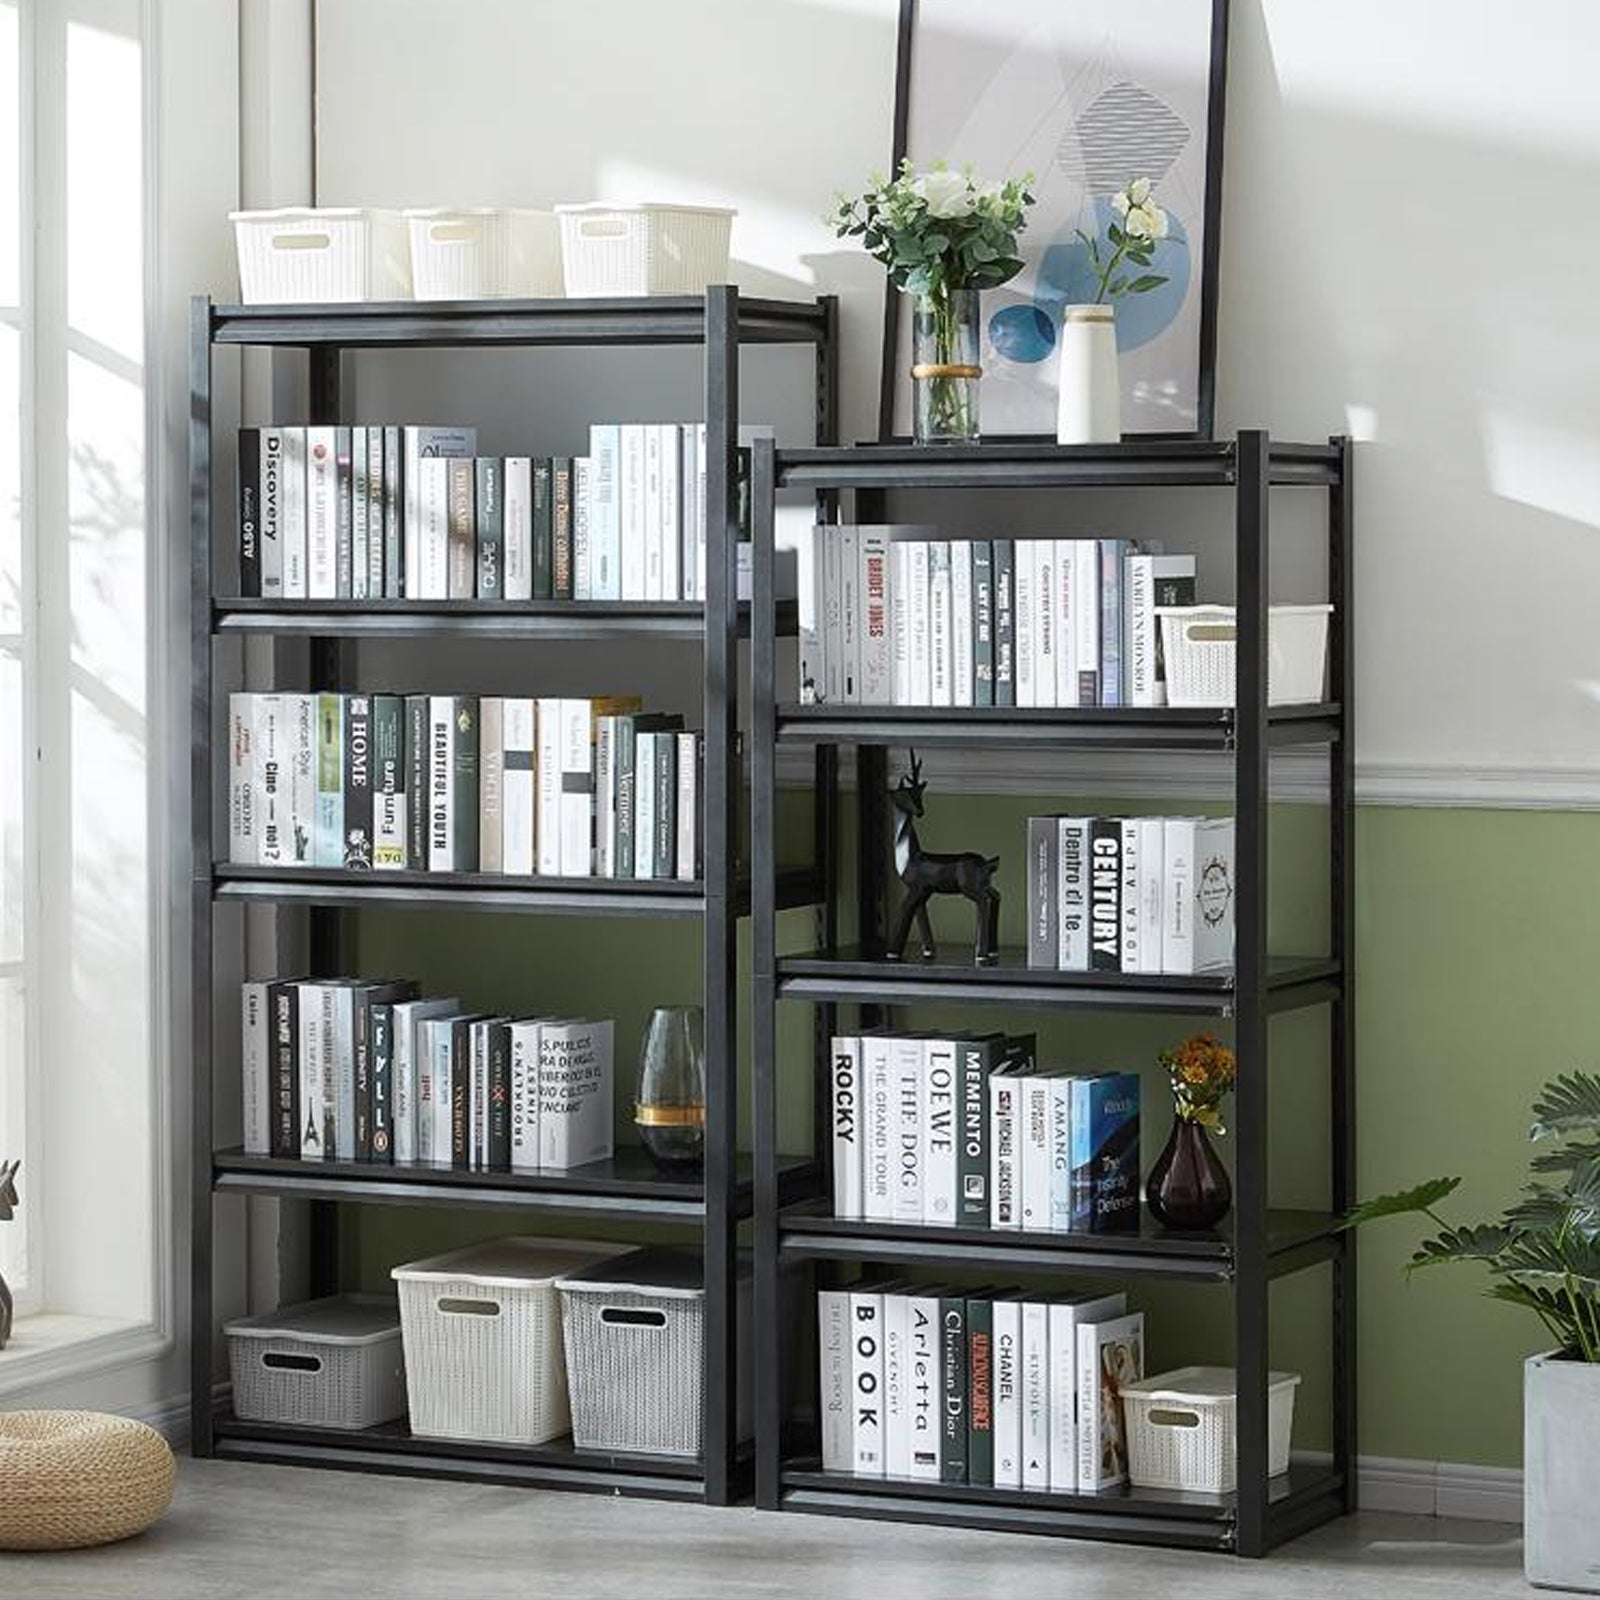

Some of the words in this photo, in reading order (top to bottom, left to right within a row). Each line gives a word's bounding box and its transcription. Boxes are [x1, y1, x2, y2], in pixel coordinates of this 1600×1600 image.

[264, 437, 282, 542] Discovery
[243, 522, 256, 559] ALSO
[1042, 565, 1052, 613] COUNTRY
[1134, 565, 1146, 631] MARILYN
[868, 604, 884, 638] JONES
[1134, 634, 1146, 693] MONROE
[299, 700, 312, 748] American
[352, 721, 367, 787] HOME
[266, 762, 279, 793] Cine
[299, 750, 312, 776] Style
[434, 723, 447, 797] BEAUTIFUL
[382, 760, 395, 834] Furniture
[434, 804, 447, 849] YOUTH
[619, 771, 633, 835] Vermeer
[1065, 827, 1084, 883] Dentro
[1065, 890, 1083, 905] di
[1065, 914, 1082, 931] te
[1092, 837, 1119, 956] CENTURY
[514, 1041, 524, 1146] BROOKLYN'S
[527, 1064, 536, 1125] FINEST
[835, 1054, 855, 1144] ROCKY
[875, 1056, 888, 1087] THE
[901, 1072, 918, 1124] THE
[875, 1090, 888, 1148] GRAND
[930, 1052, 952, 1154] LOEWE
[966, 1051, 981, 1158] MEMENTO
[901, 1134, 918, 1187] DOG
[998, 1118, 1013, 1157] MICHAEL
[875, 1154, 888, 1197] TOUR
[856, 1305, 877, 1427] BOOK
[889, 1332, 899, 1415] GIVENCHY
[914, 1308, 931, 1431] Arletta
[944, 1310, 962, 1390] Christian
[1000, 1334, 1013, 1403] CHANEL
[1030, 1353, 1039, 1417] KINFOLK
[946, 1396, 963, 1440] Dior
